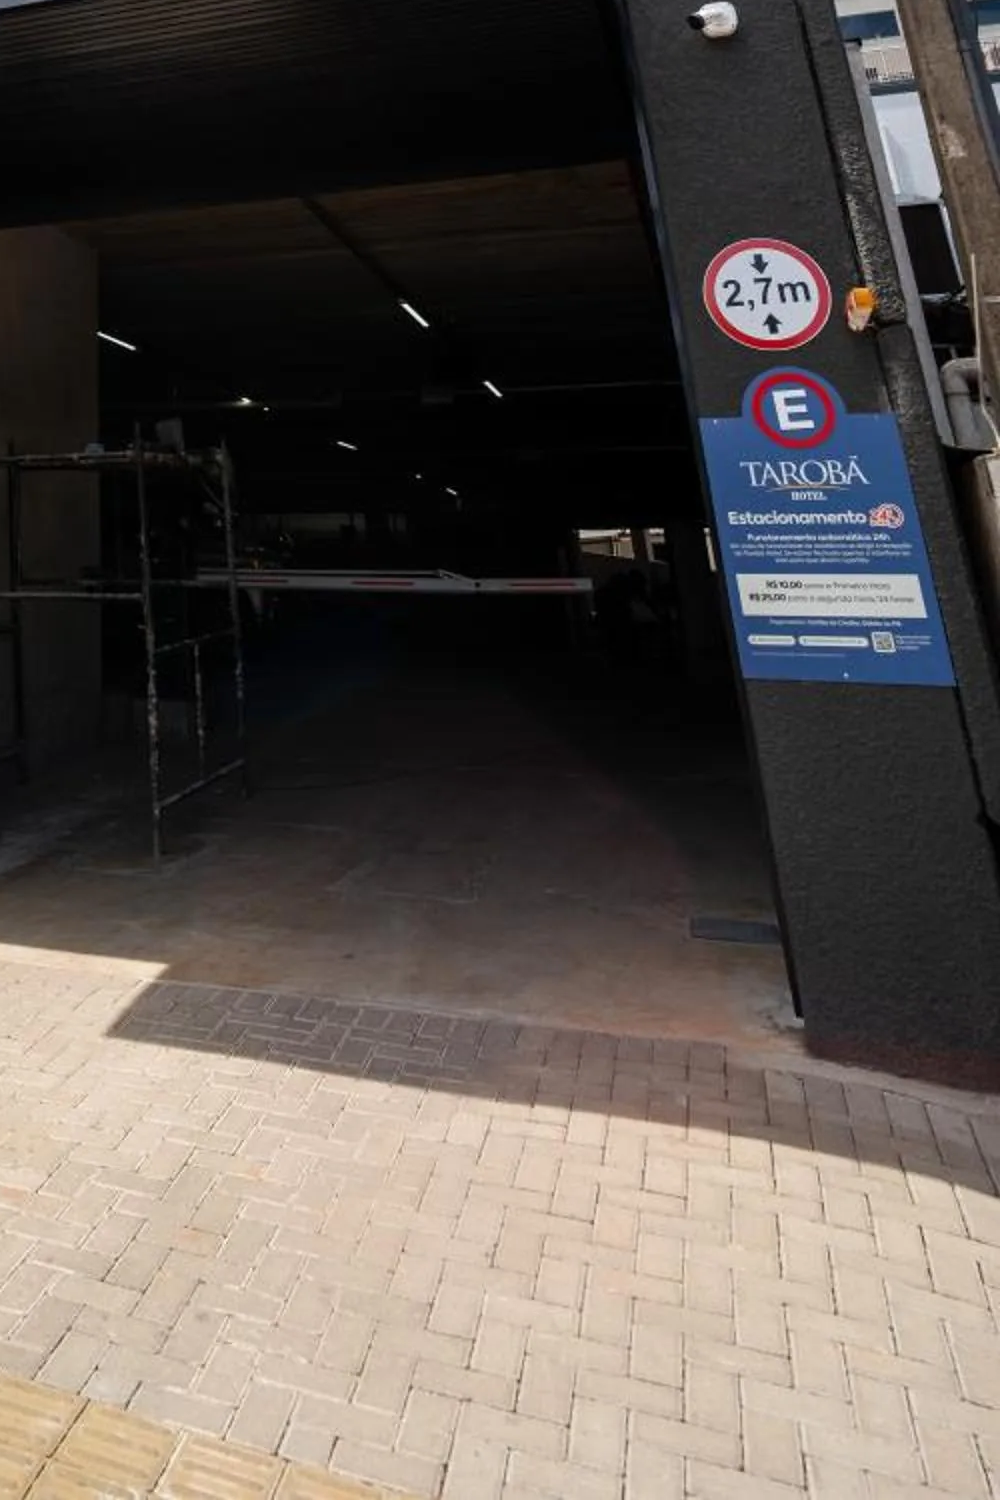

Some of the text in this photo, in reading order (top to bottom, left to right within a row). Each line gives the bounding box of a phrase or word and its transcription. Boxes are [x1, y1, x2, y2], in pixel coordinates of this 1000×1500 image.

[722, 277, 811, 311] 2,7m
[771, 388, 815, 431] E
[739, 455, 870, 486] TAROBÁ
[727, 510, 867, 526] Estacionamento
